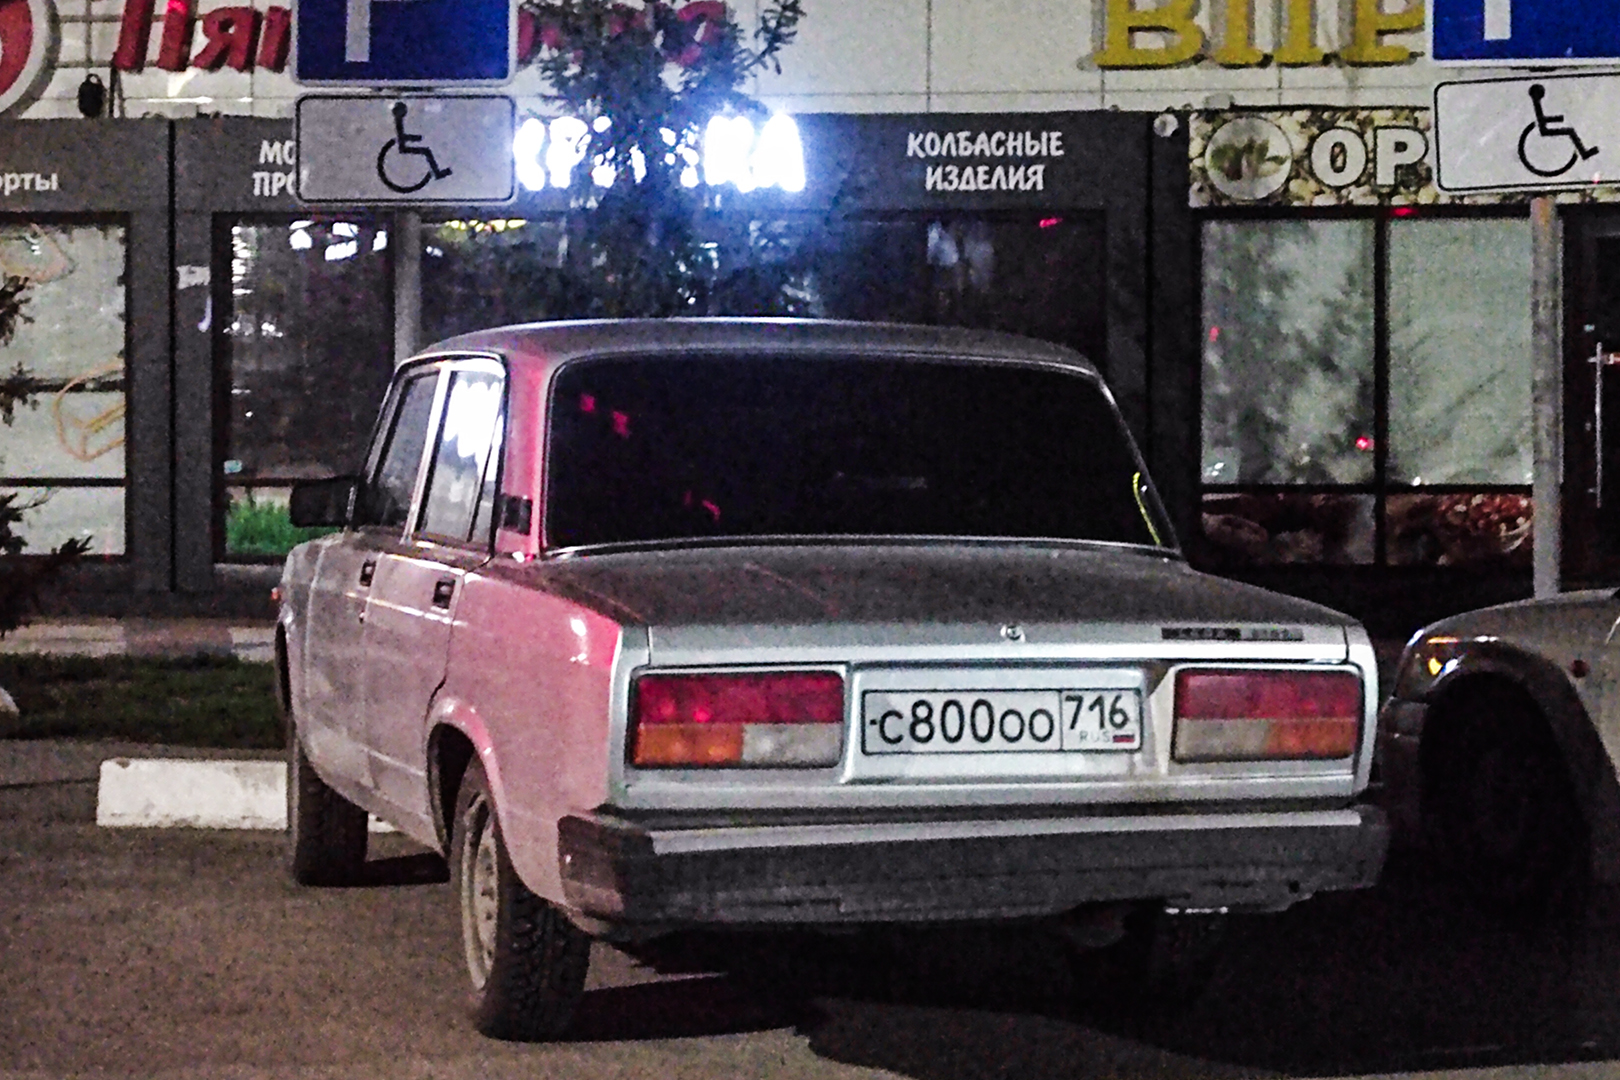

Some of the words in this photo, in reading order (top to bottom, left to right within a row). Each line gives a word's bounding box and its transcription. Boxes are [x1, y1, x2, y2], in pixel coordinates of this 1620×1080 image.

[906, 130, 1065, 158] КОЛБАСНЫЕ
[925, 164, 1046, 191] ИЗДЕЛИЯ
[1064, 695, 1129, 730] 716
